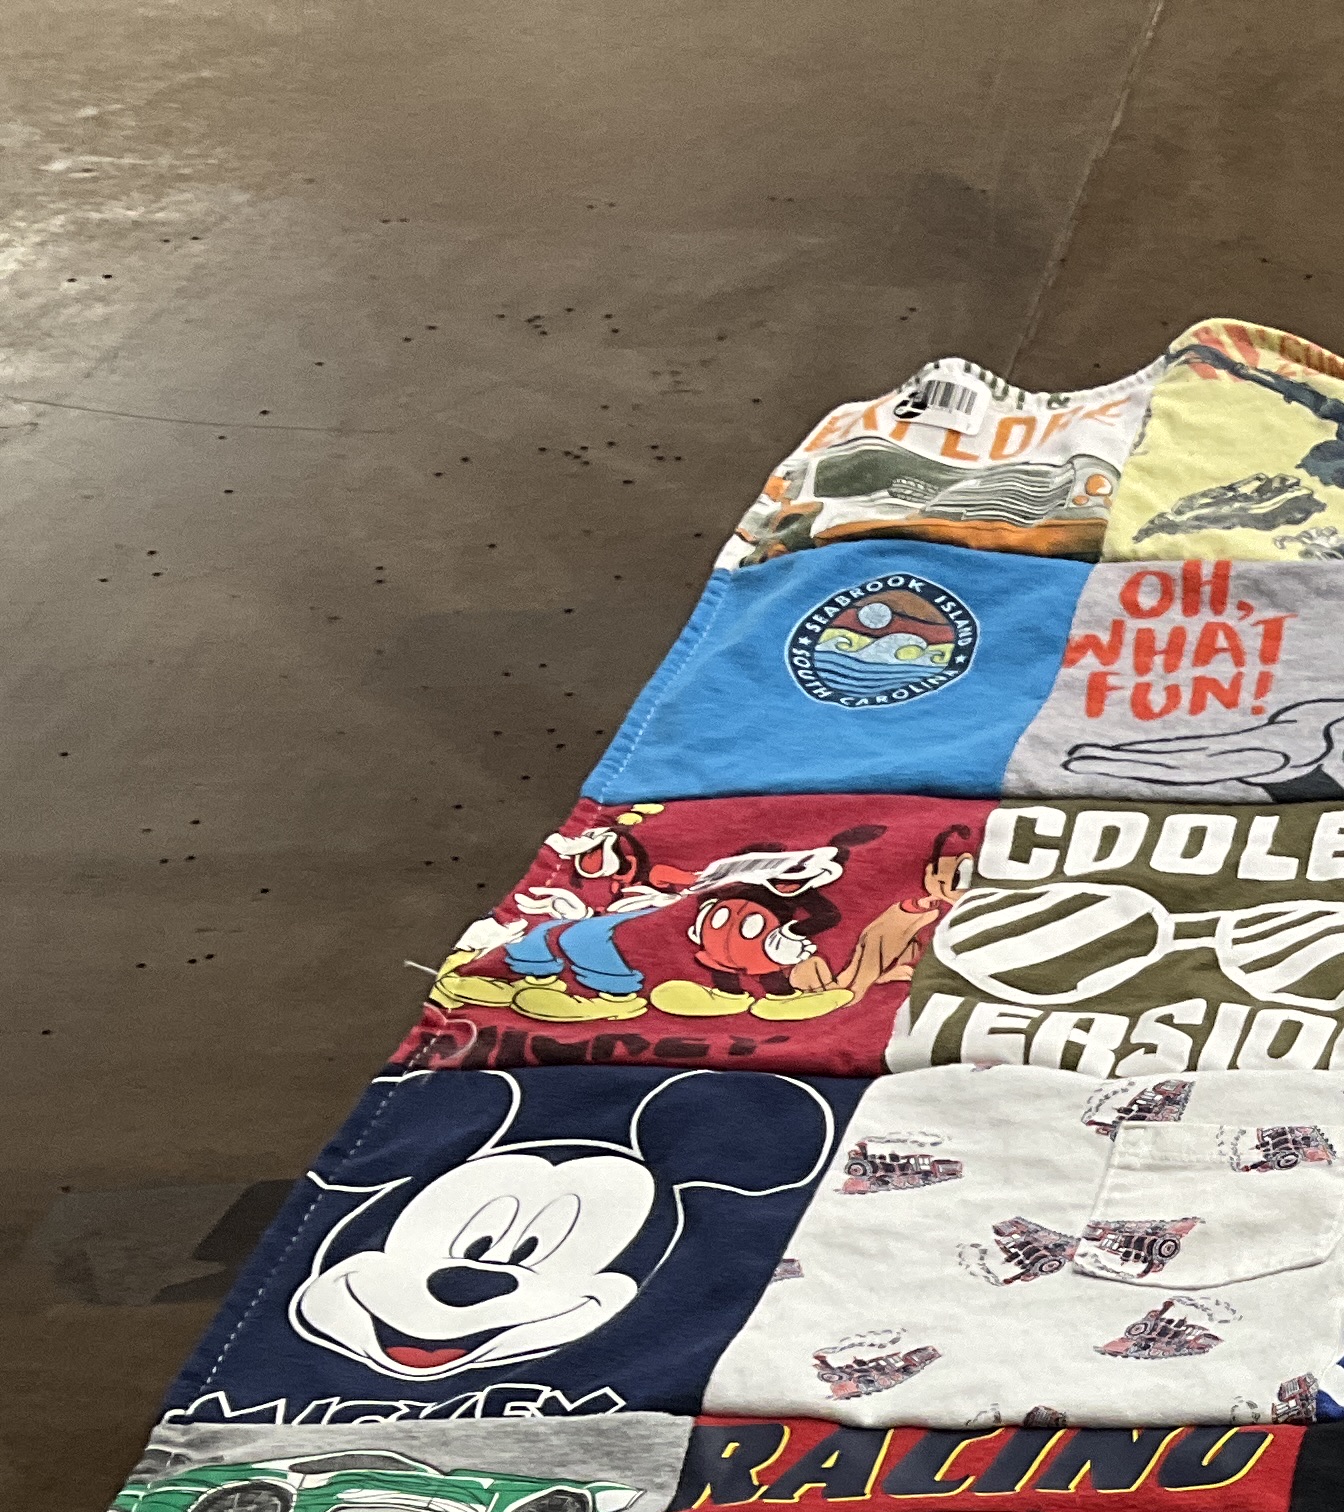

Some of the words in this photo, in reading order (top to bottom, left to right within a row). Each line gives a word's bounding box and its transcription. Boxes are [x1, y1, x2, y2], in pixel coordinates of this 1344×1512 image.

[805, 574, 926, 634] SEABROOK
[934, 595, 974, 647] ISLAND
[1119, 559, 1255, 620] OH,
[1062, 612, 1298, 677] WHAT
[792, 647, 834, 699] SOUTH
[839, 669, 960, 707] CAROLINA
[1085, 671, 1275, 721] FUN!
